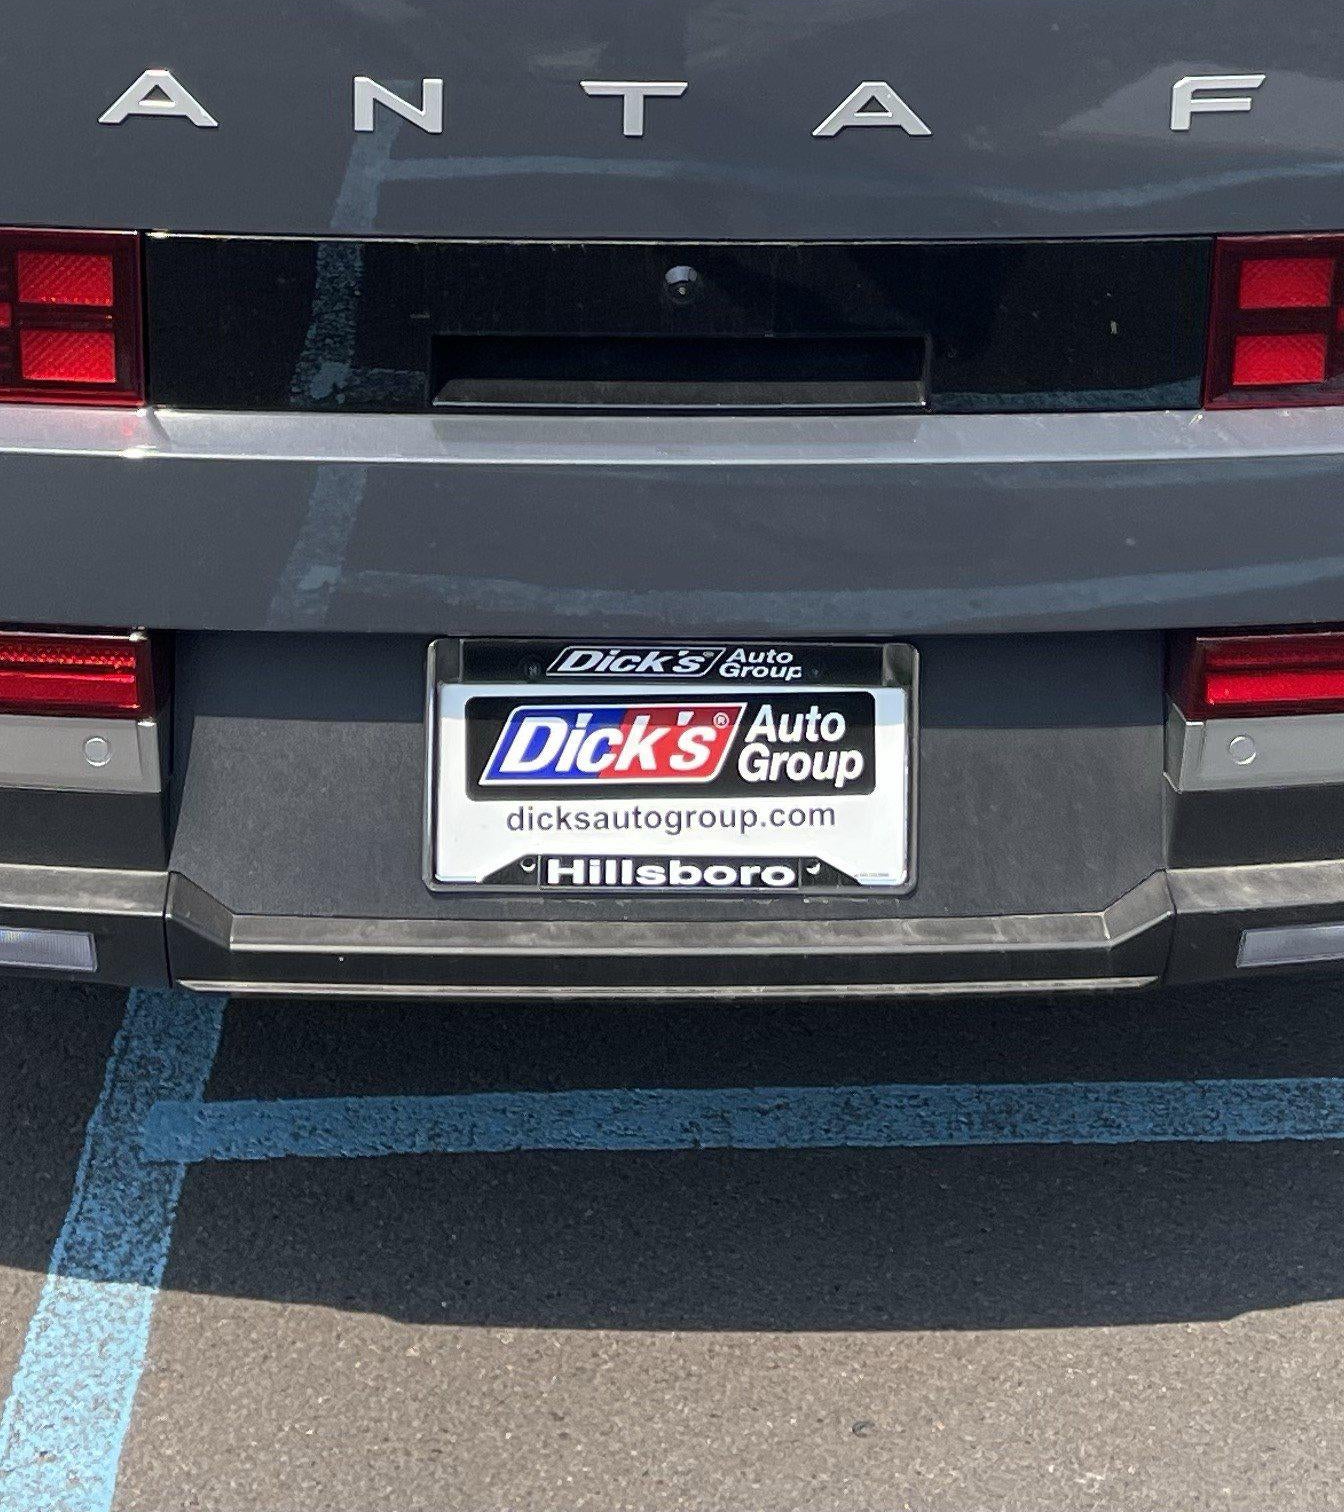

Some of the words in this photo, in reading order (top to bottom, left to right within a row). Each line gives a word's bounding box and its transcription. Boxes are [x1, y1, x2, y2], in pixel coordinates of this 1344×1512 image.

[557, 649, 706, 673] Dick's
[726, 648, 794, 664] Auto
[719, 662, 802, 680] Group
[746, 704, 846, 742] Auto
[499, 711, 715, 774] Dick's
[738, 744, 864, 787] Group
[506, 803, 836, 834] dicksautogroup.com
[547, 859, 798, 886] Hillsboro
